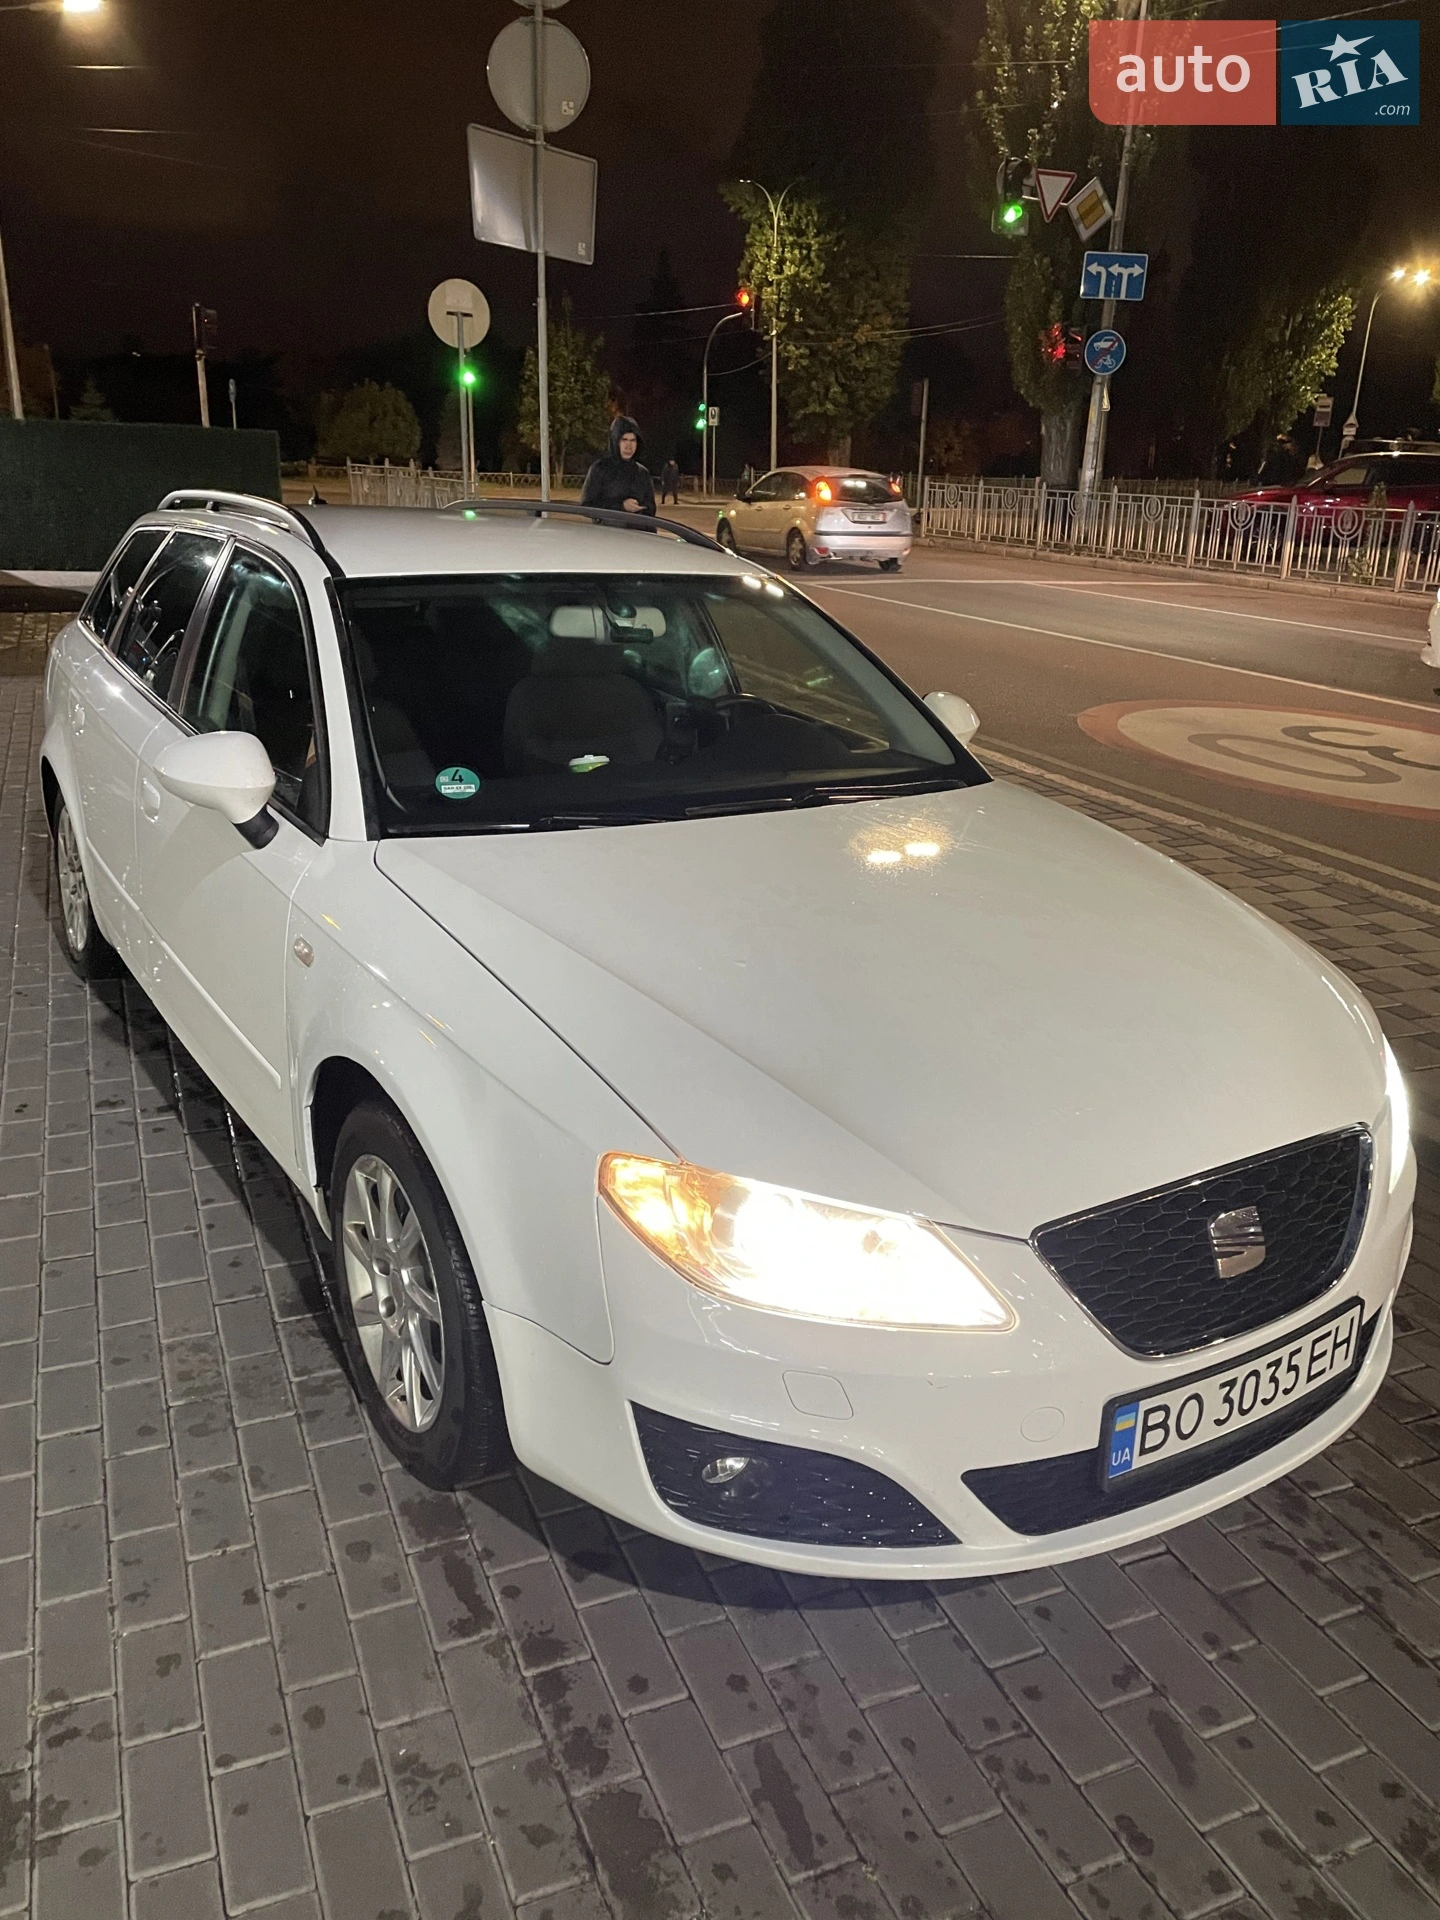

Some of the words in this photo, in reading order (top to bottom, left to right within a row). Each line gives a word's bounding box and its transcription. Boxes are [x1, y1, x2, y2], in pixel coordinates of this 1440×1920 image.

[451, 769, 464, 783] 4
[1213, 1346, 1303, 1427] 3035
[1112, 1447, 1131, 1466] UA
